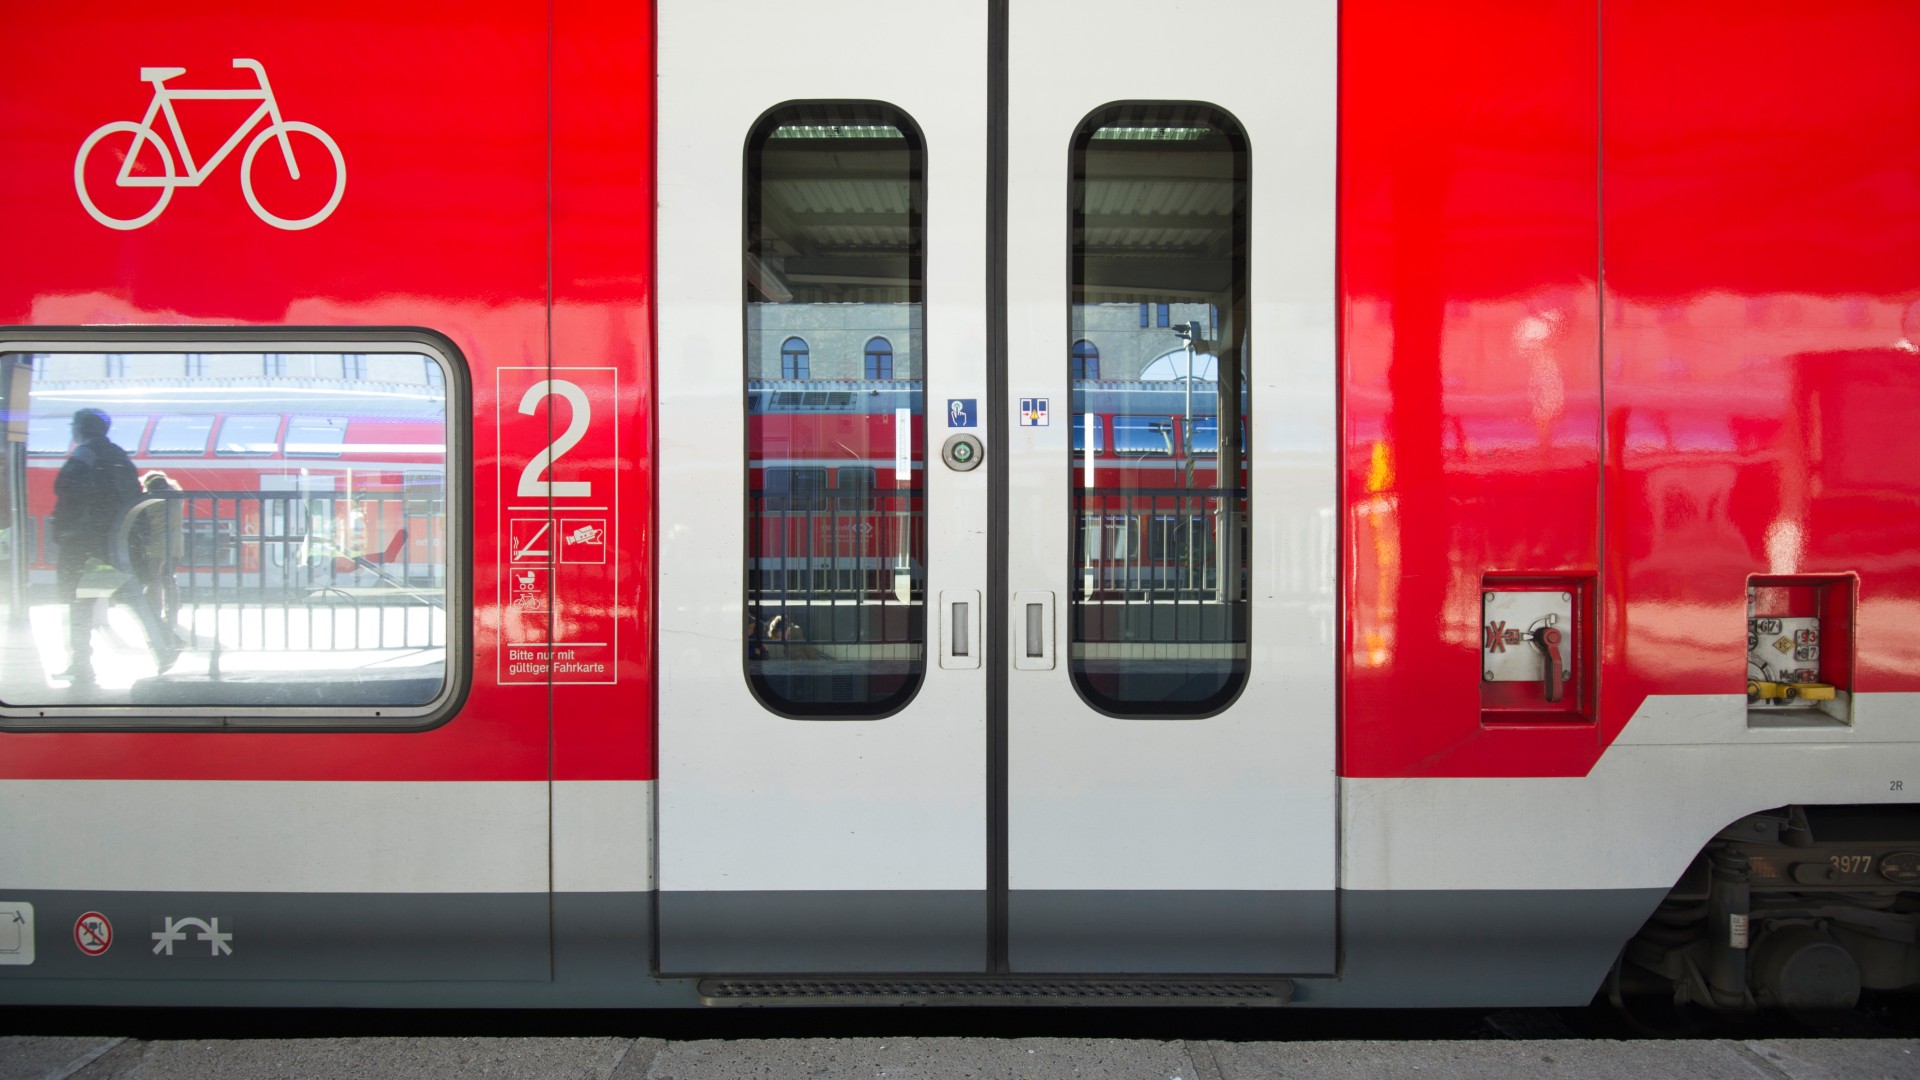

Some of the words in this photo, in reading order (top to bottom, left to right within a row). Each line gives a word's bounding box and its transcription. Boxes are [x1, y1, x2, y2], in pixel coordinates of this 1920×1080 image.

[517, 379, 591, 497] 2
[1760, 620, 1776, 632] 67
[1801, 631, 1816, 643] 93
[509, 649, 534, 660] Bitte
[536, 652, 555, 660] nur
[557, 649, 575, 660] mit
[509, 662, 550, 675] gültiger
[553, 662, 604, 673] Fahrkarte
[1889, 780, 1903, 791] 2R
[1829, 855, 1872, 873] 3977
